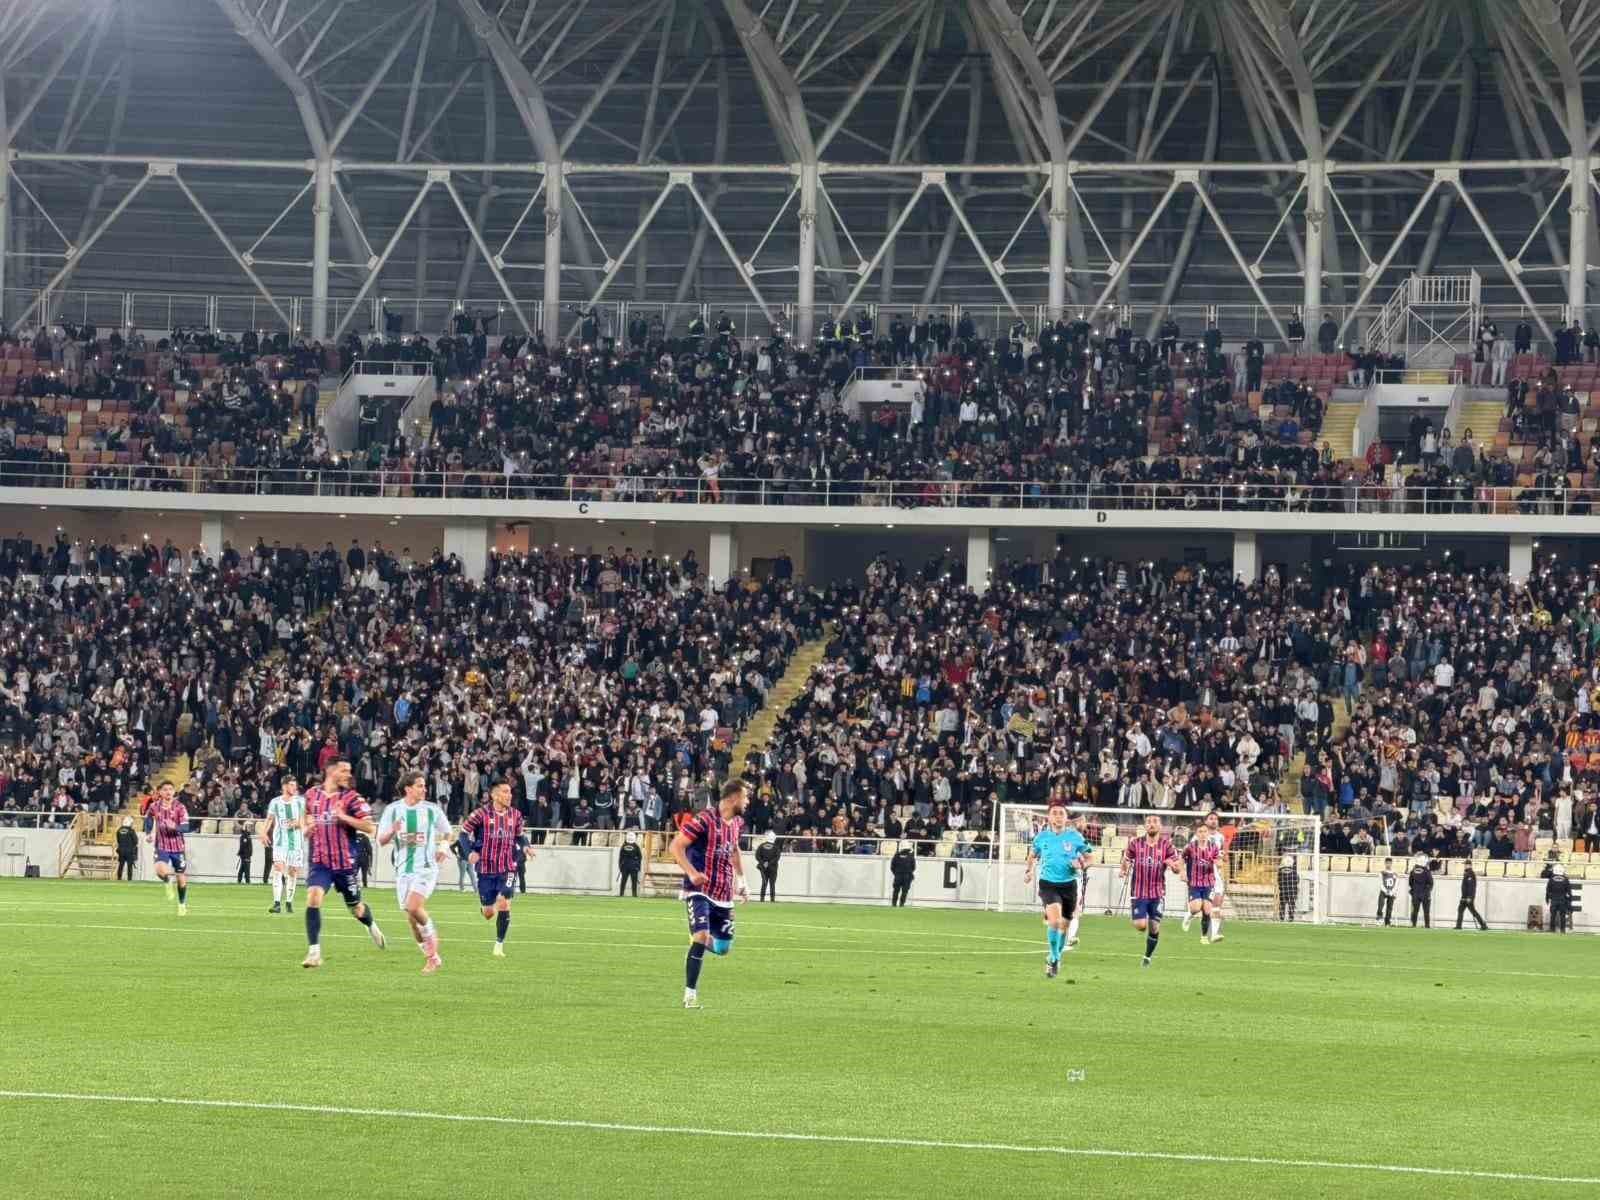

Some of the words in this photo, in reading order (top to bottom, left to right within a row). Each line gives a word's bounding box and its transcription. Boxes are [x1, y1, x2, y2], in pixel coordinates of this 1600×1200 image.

[578, 503, 589, 514] C
[1097, 511, 1107, 523] D
[943, 860, 964, 889] D
